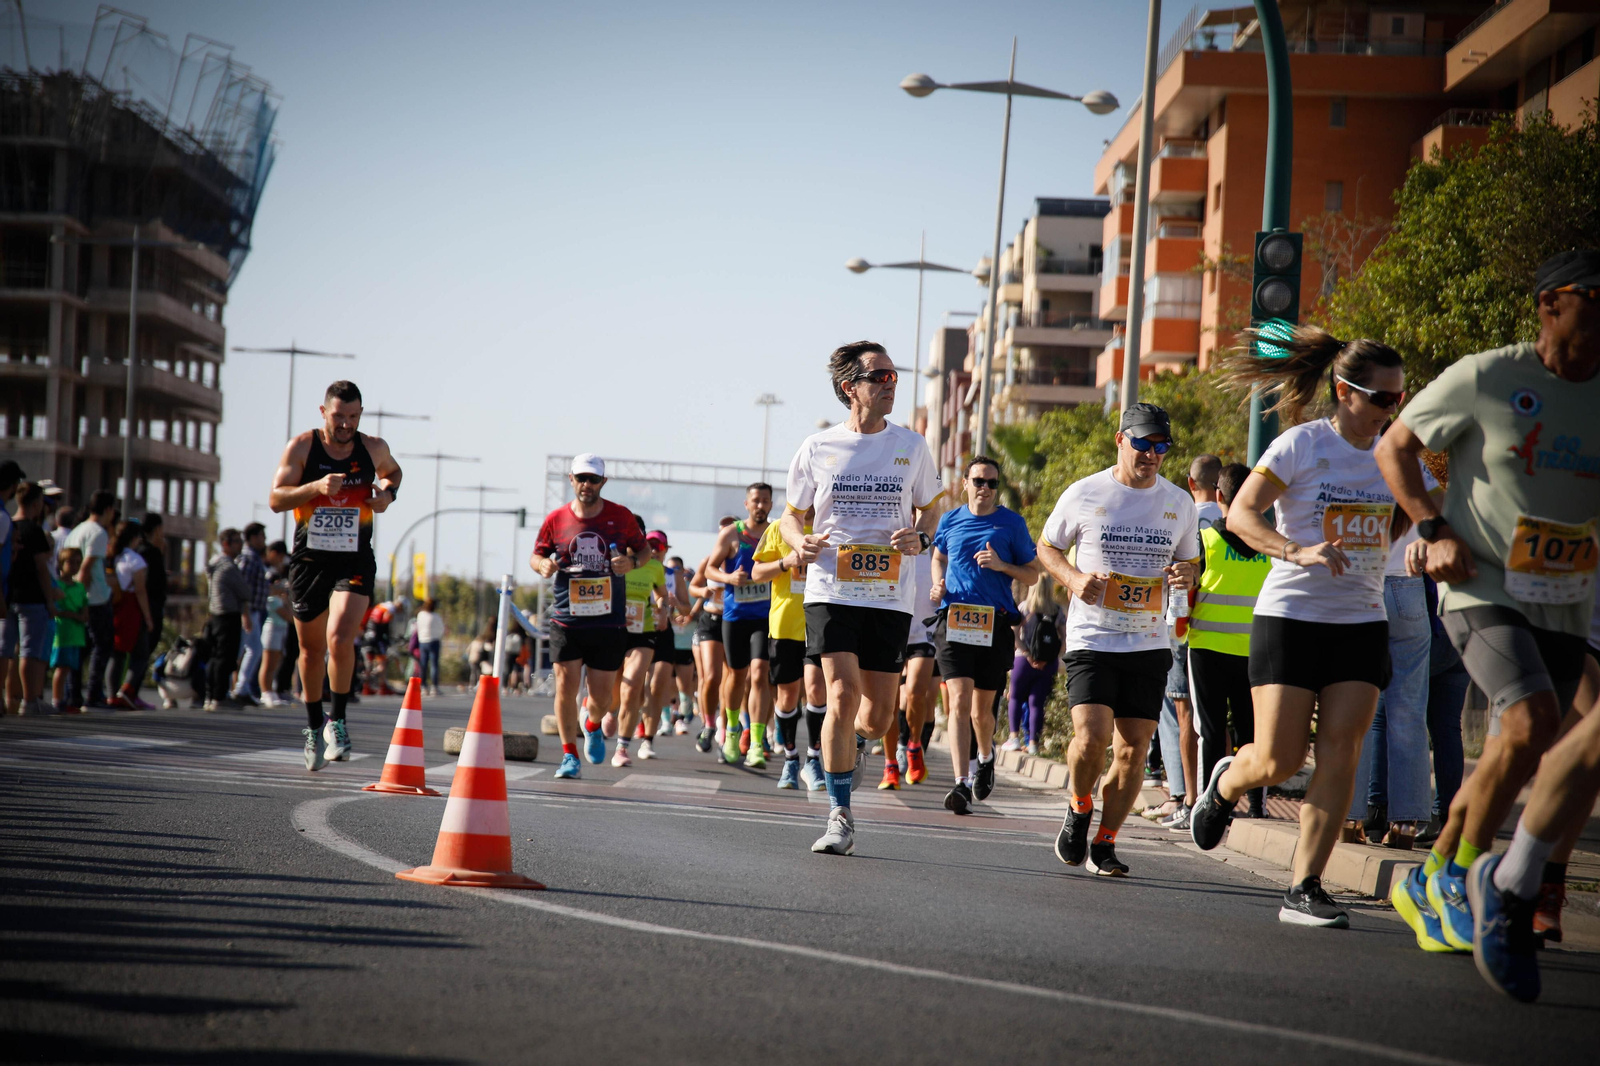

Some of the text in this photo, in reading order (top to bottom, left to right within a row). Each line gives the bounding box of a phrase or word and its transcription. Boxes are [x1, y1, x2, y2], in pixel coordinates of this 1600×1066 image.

[832, 474, 904, 483] Medio Maratón
[832, 482, 903, 493] Almería 2024
[1319, 482, 1352, 496] Medio
[314, 515, 354, 528] 5205
[1100, 524, 1173, 537] Medio Maratón
[1100, 533, 1173, 546] Almería 2024
[850, 553, 890, 572] 885
[578, 584, 604, 596] 842
[738, 584, 766, 595] 1110
[1118, 584, 1152, 603] 351
[953, 610, 988, 625] 1431
